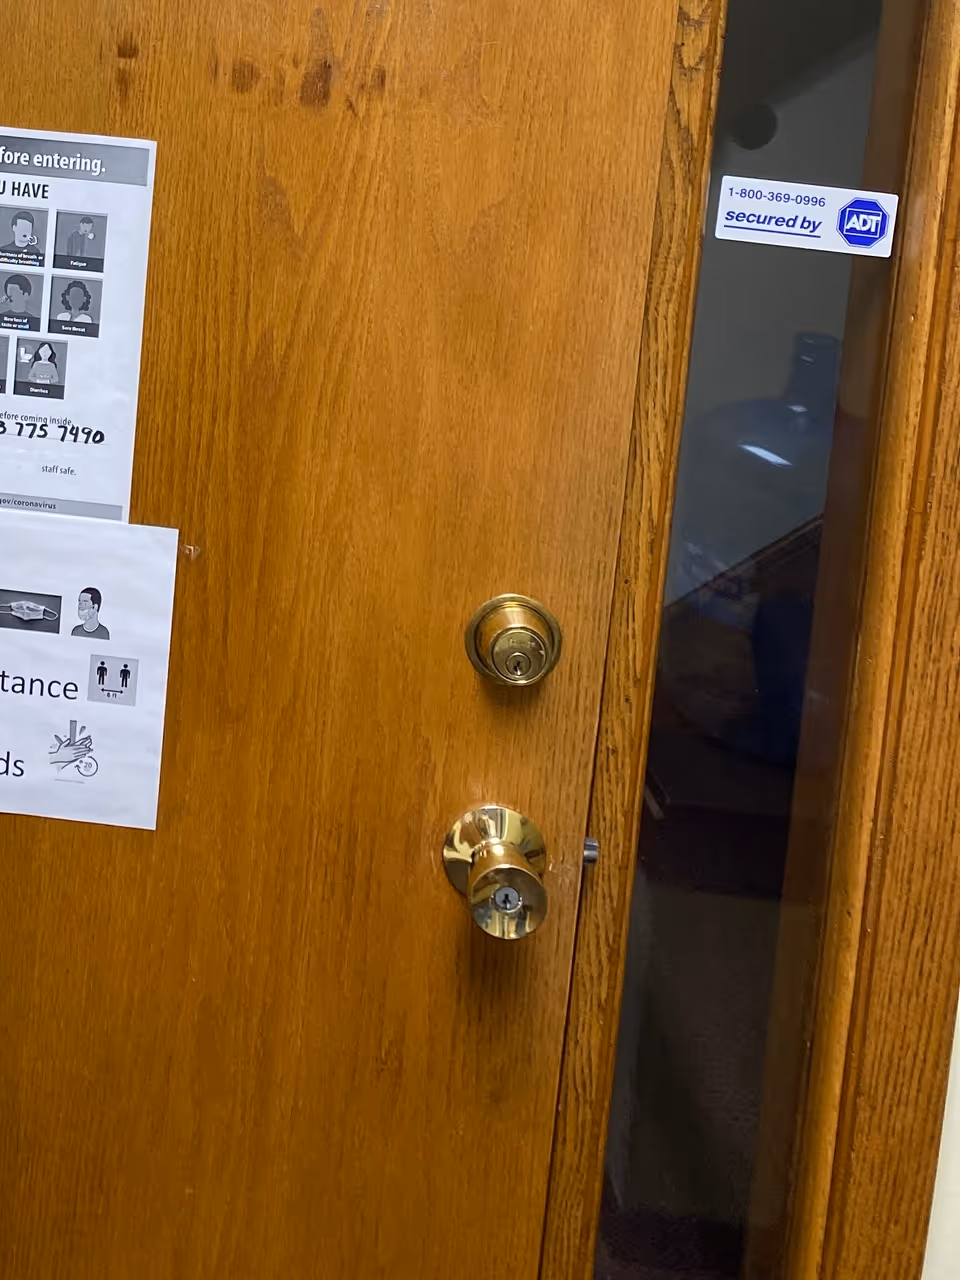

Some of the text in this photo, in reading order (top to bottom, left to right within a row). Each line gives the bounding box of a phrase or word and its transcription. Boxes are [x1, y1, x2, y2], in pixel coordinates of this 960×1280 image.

[33, 153, 106, 177] entering.
[11, 181, 50, 200] HAVE
[728, 186, 826, 208] 1-800-369-0996
[724, 209, 882, 234] secured by ADT
[20, 414, 48, 424] coming
[15, 422, 48, 439] 775
[57, 424, 105, 444] 7490
[41, 465, 58, 473] staff
[59, 466, 77, 476] safe.
